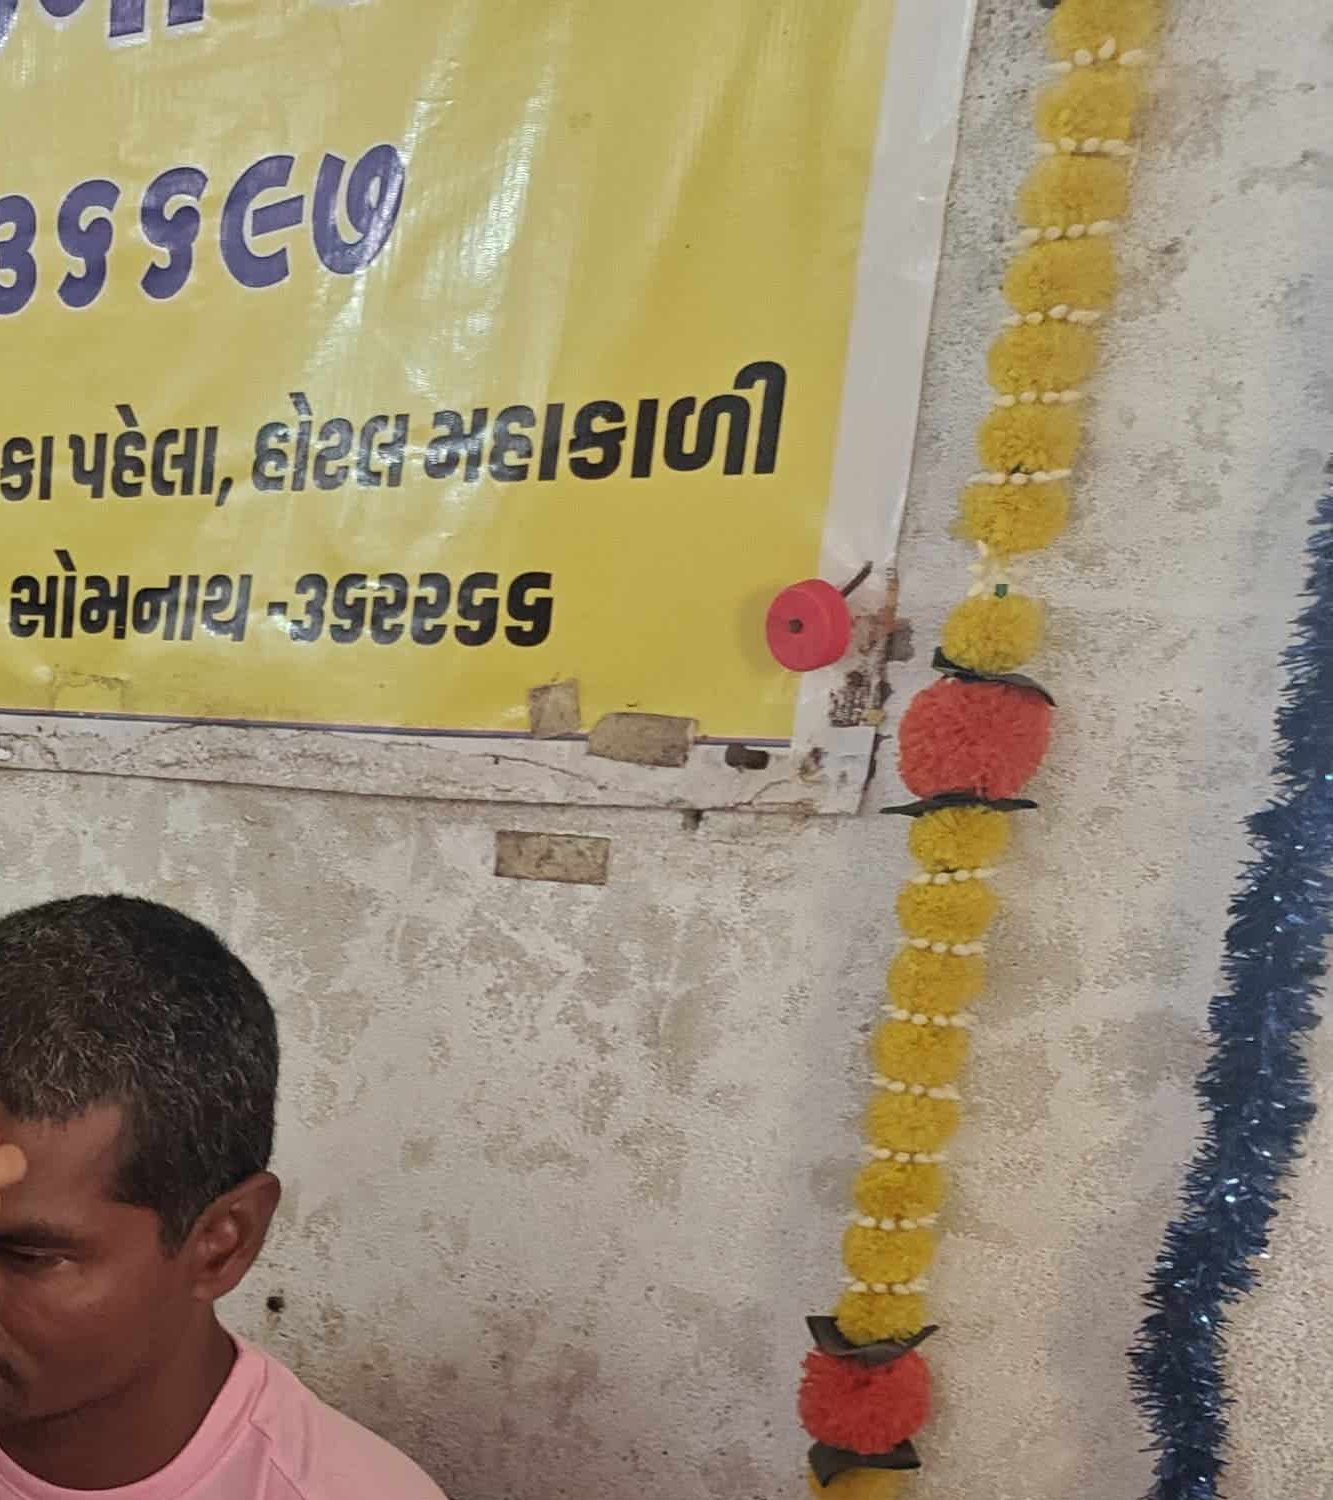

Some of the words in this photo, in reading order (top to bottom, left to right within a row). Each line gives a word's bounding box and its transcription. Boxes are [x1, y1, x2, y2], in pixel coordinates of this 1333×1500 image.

[69, 404, 234, 507] પહેલા,
[252, 392, 410, 492] હોટલ
[423, 361, 788, 482] મહાકાળી
[8, 549, 253, 641] સોમનાથ
